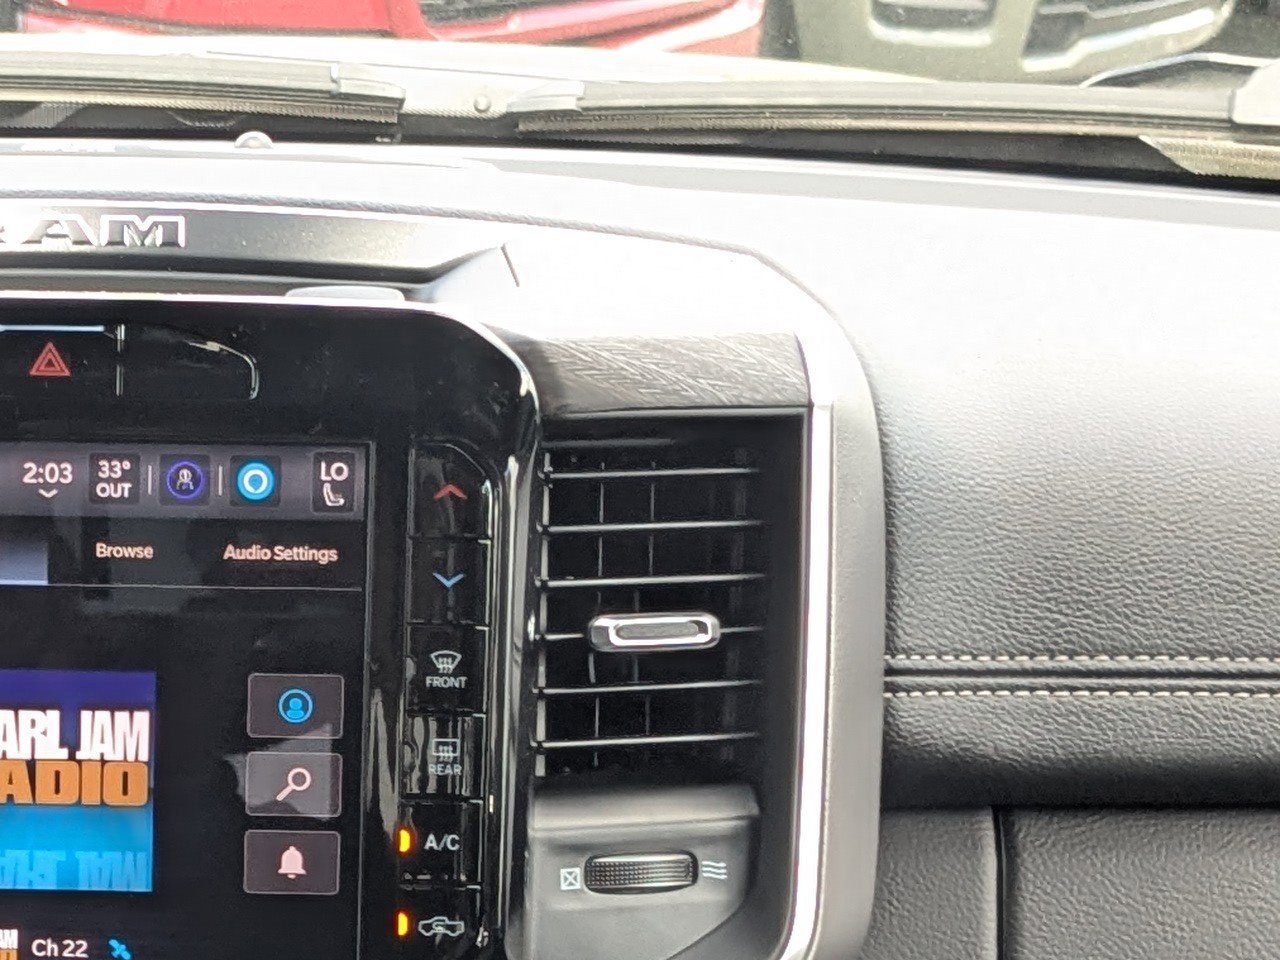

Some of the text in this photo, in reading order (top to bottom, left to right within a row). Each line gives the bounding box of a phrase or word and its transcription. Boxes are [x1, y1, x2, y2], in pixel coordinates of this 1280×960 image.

[22, 462, 73, 484] 2:03
[98, 460, 131, 478] 33°
[321, 462, 349, 481] LO
[96, 483, 132, 498] OUT
[96, 543, 154, 560] Browse
[223, 544, 338, 565] Audio Settings
[425, 676, 467, 689] FRONT
[75, 710, 150, 762] JAM
[428, 764, 462, 776] REAR
[424, 834, 460, 850] A/C
[31, 938, 89, 958] Ch 22
